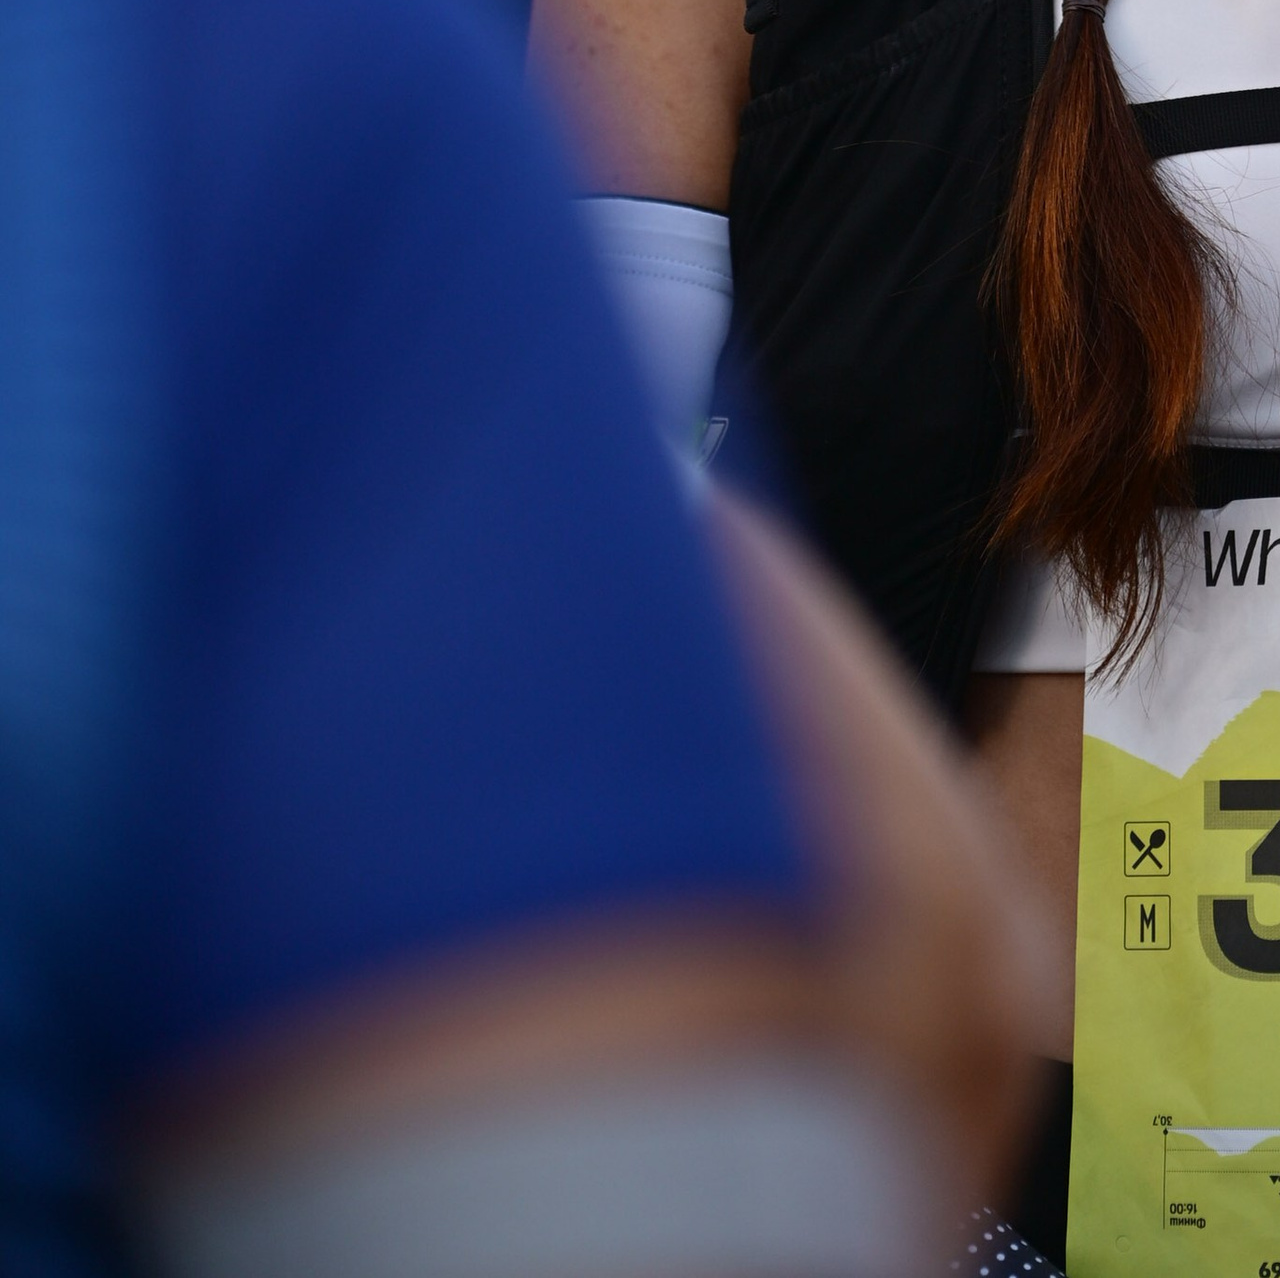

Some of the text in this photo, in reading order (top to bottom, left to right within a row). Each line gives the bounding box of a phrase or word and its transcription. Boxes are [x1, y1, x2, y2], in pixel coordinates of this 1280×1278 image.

[1153, 1114, 1173, 1126] 30,7
[1170, 1203, 1198, 1214] 16:00
[1170, 1217, 1206, 1229] Финиш
